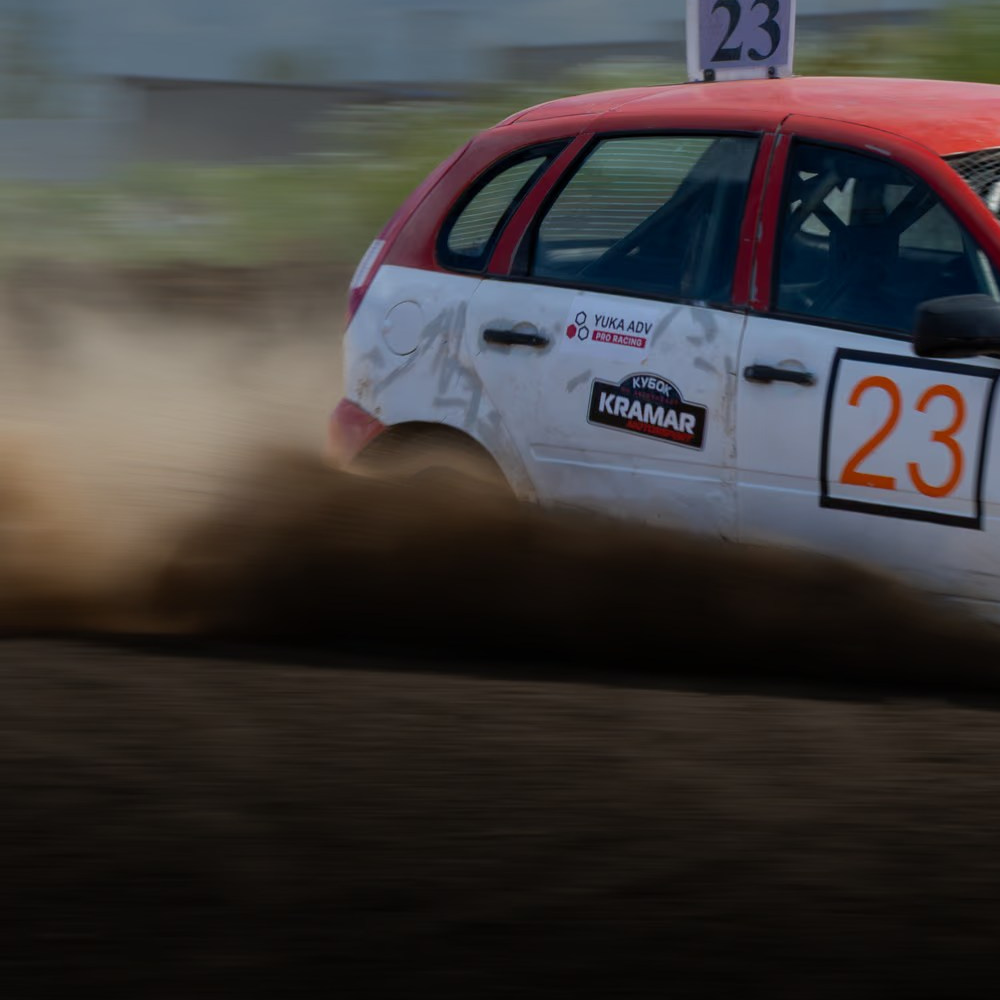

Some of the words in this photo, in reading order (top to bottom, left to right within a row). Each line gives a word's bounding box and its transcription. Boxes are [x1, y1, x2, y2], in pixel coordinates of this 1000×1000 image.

[594, 314, 624, 331] YUKA
[627, 319, 653, 335] ADV
[595, 333, 611, 342] PRO
[613, 335, 643, 347] RACING
[632, 377, 673, 397] КУБОК
[599, 392, 696, 434] KRAMAR
[840, 375, 967, 498] 23
